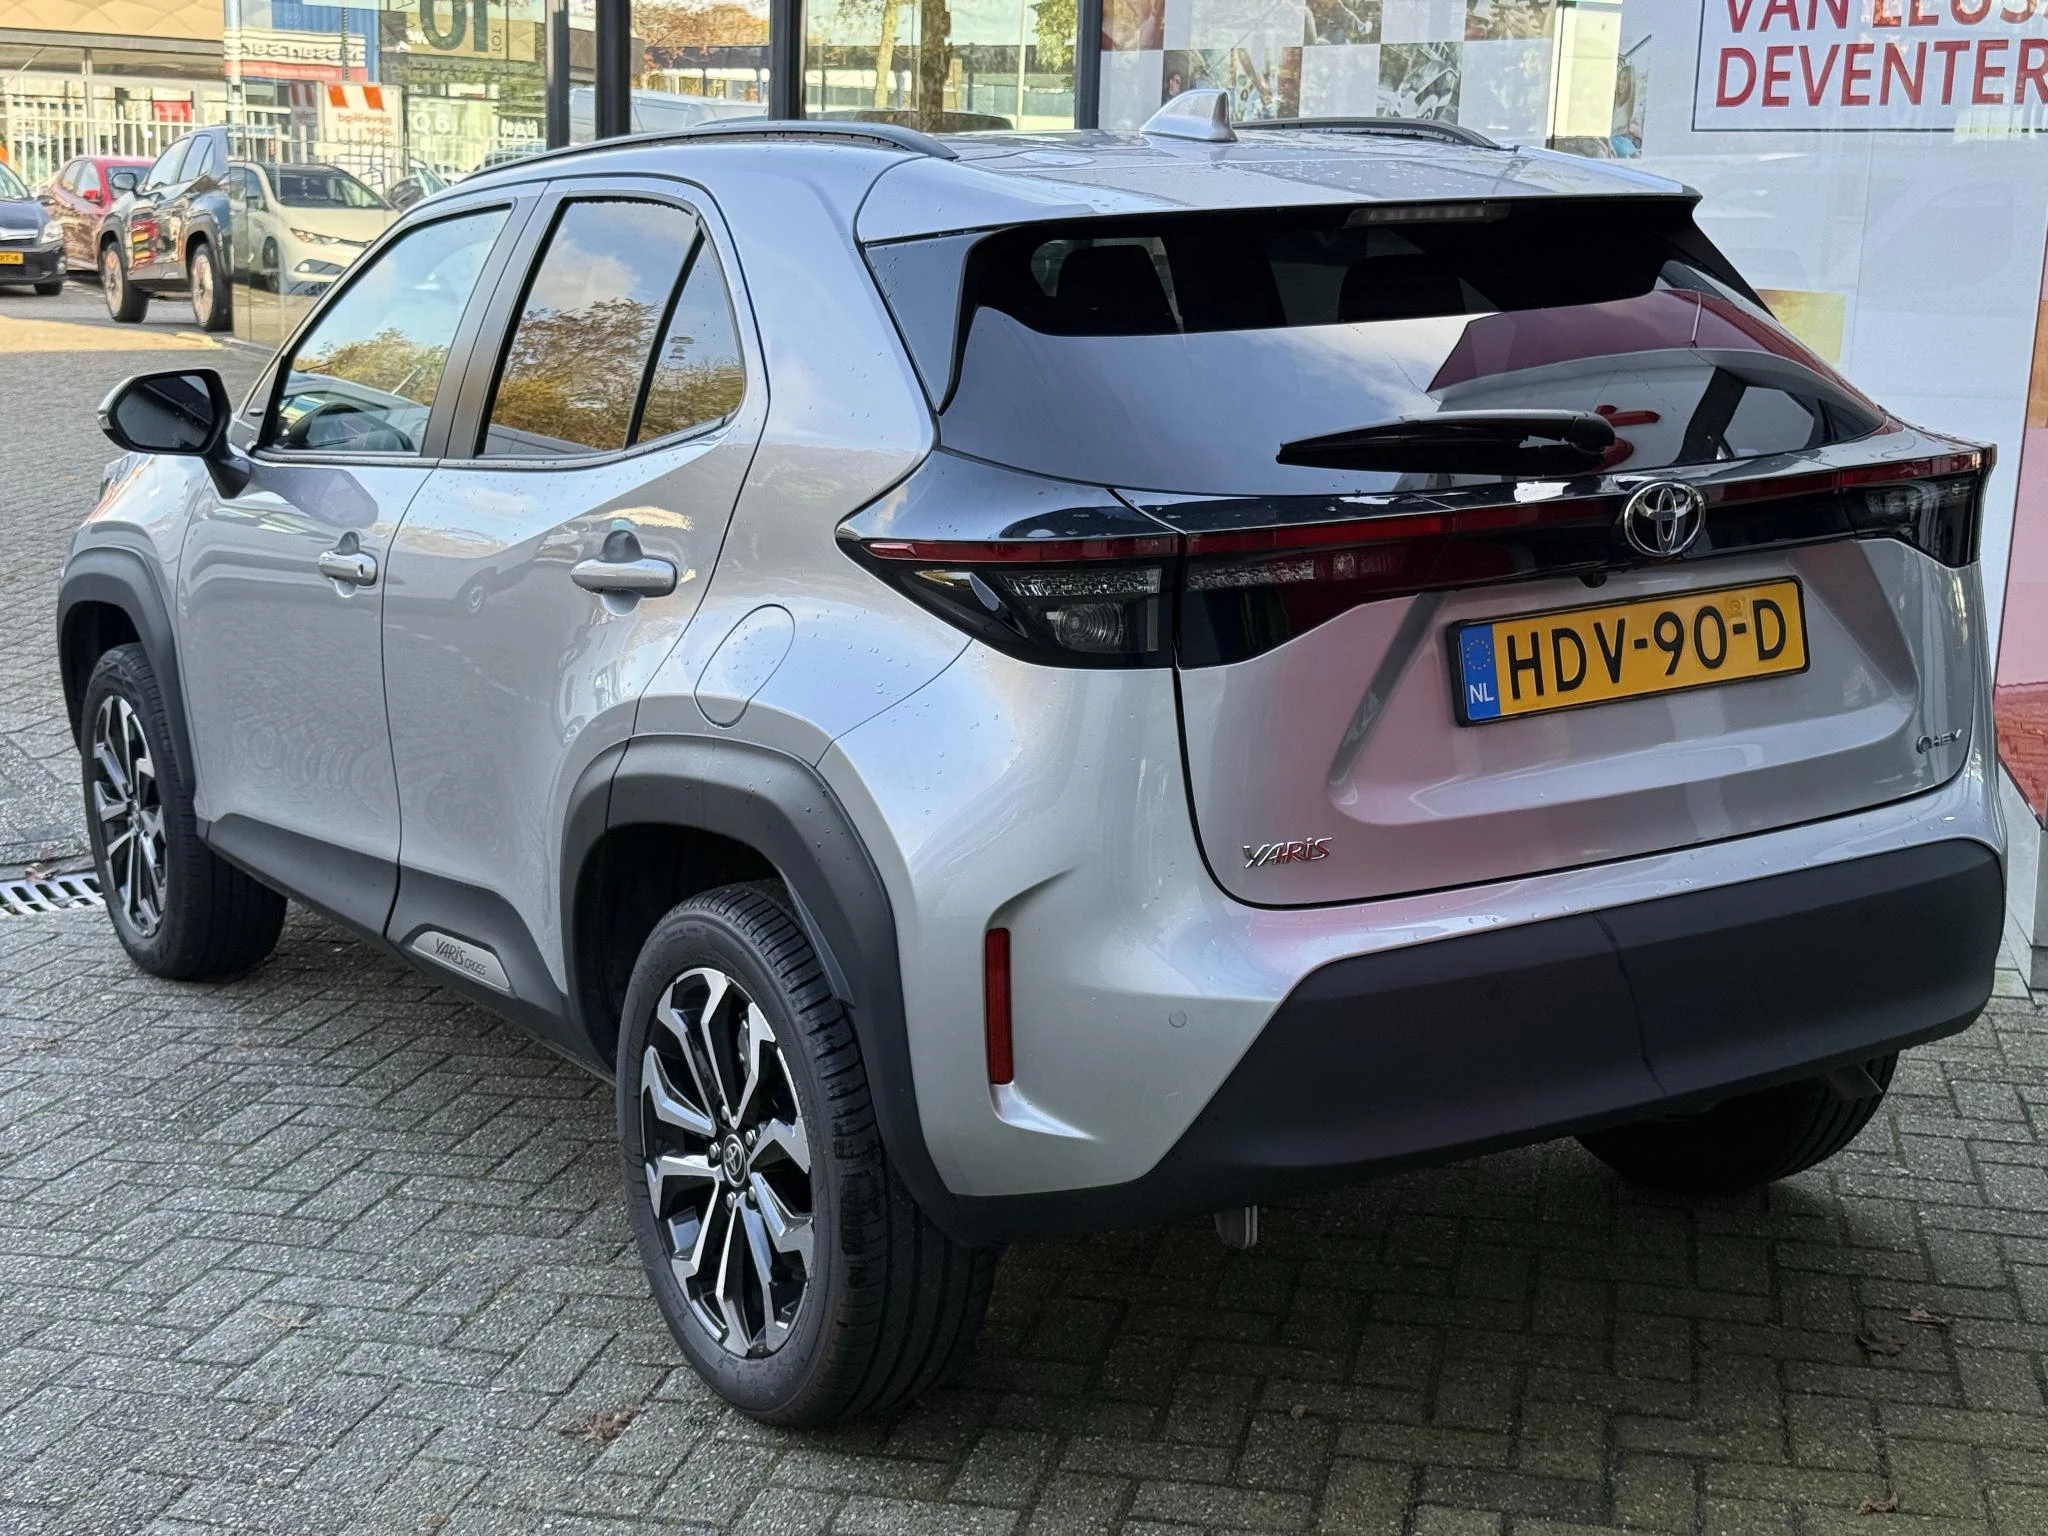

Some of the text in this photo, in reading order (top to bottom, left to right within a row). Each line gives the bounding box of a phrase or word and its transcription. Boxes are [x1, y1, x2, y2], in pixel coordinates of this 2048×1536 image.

[1716, 38, 2048, 108] DEVENTER
[1506, 598, 1788, 701] HDV-90-D
[1468, 682, 1495, 705] NL
